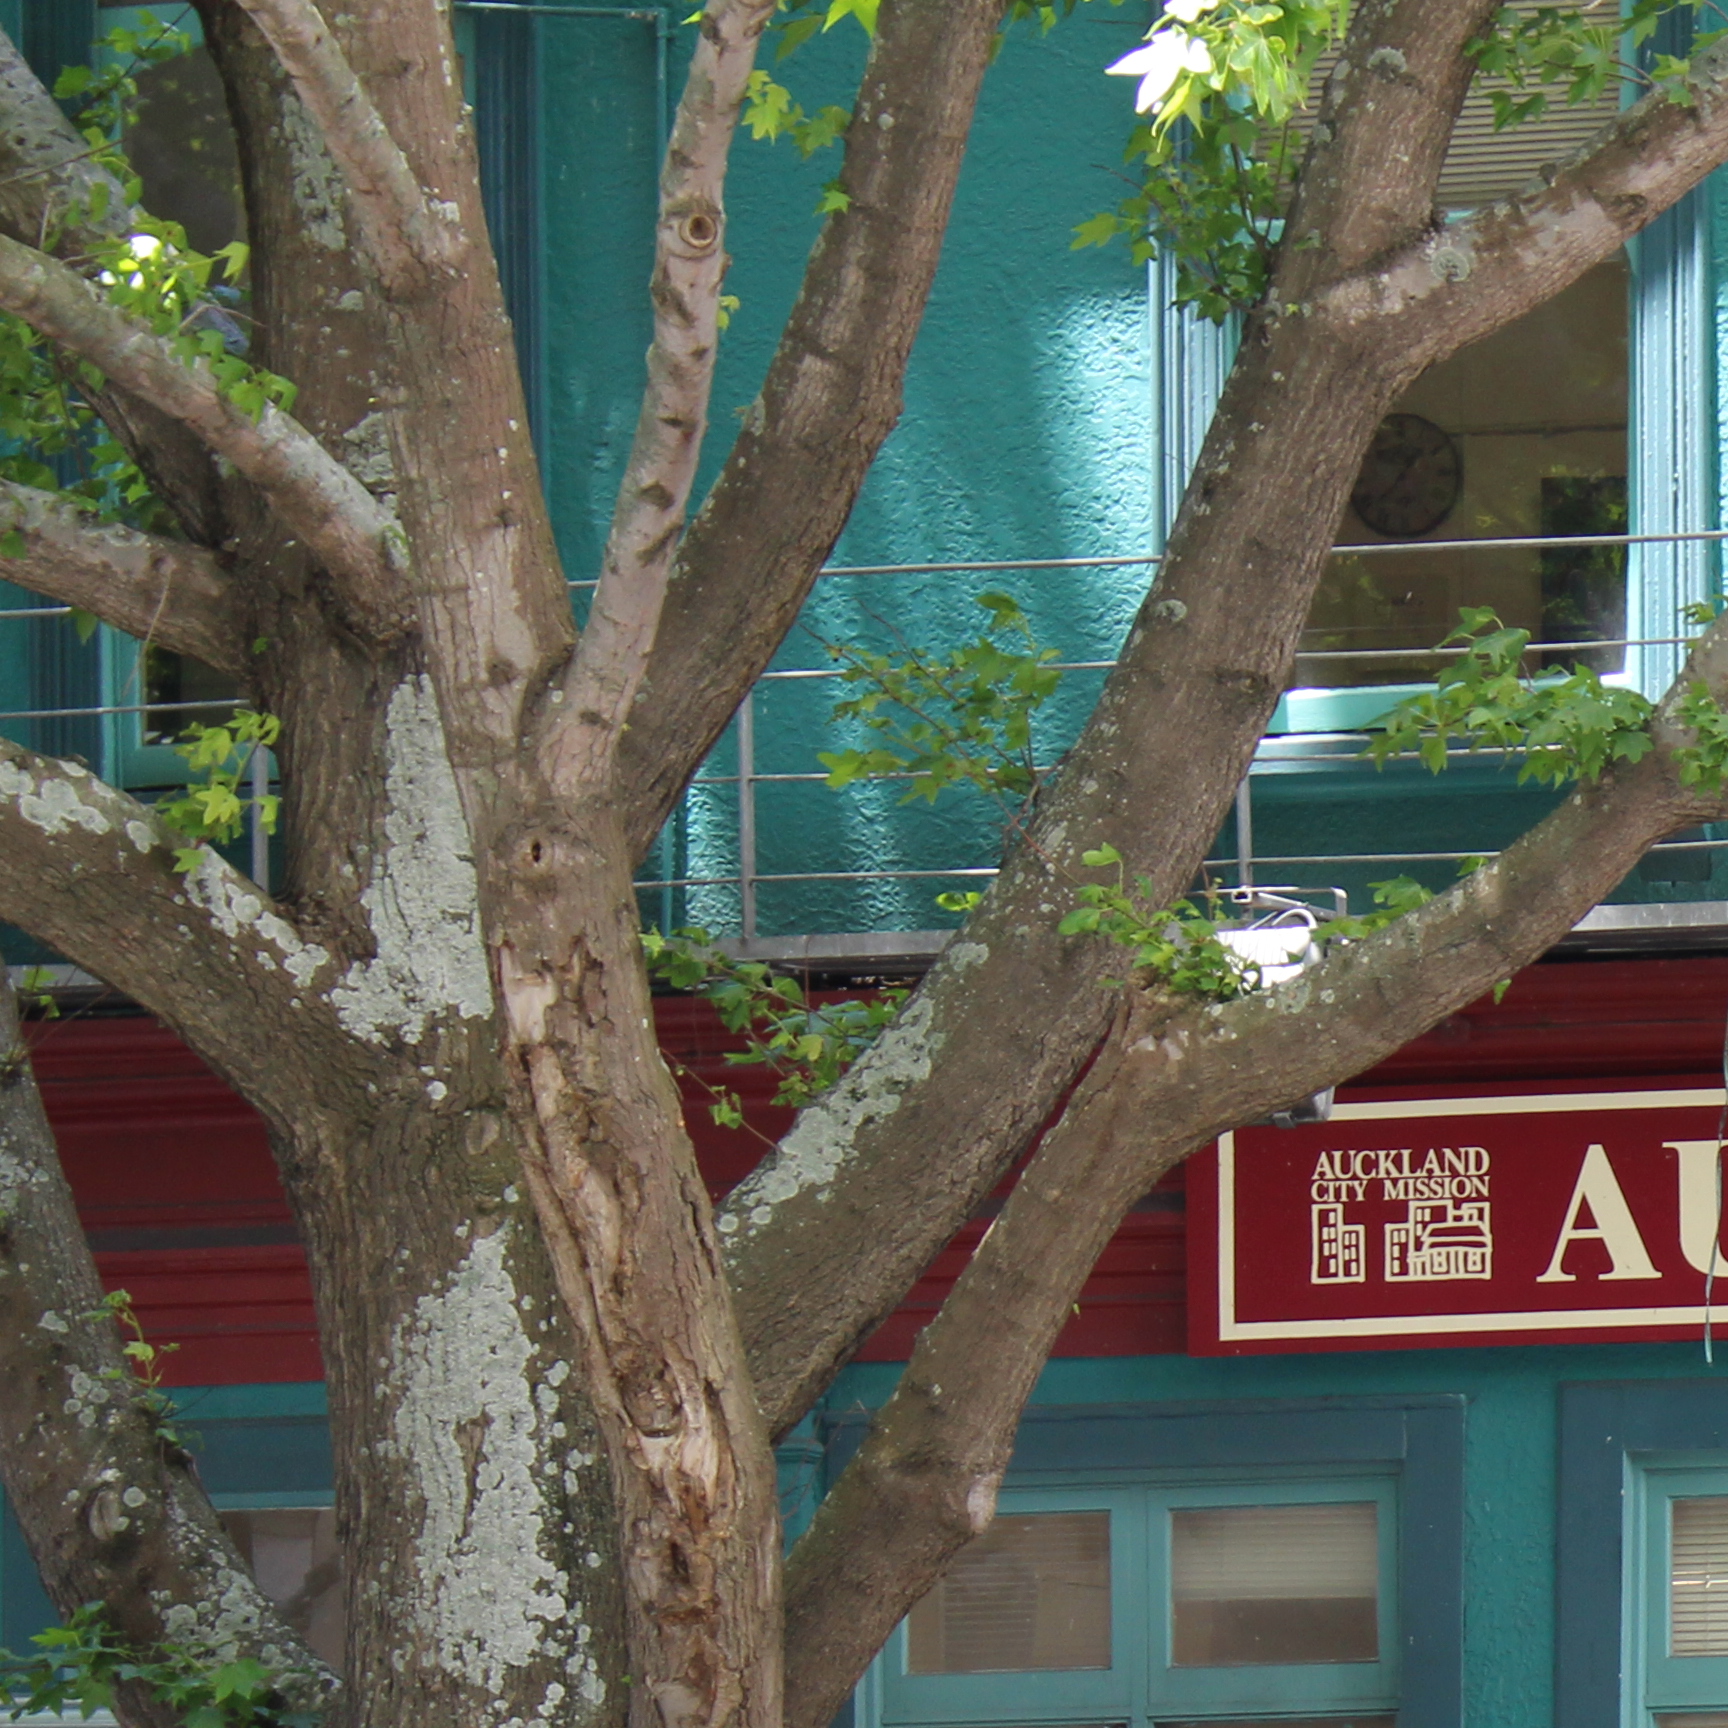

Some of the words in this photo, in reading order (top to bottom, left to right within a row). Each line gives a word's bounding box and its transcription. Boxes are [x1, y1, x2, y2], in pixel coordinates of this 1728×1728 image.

[1311, 1147, 1491, 1180] AUCKLAND
[1311, 1179, 1369, 1202] CITY
[1383, 1175, 1490, 1200] MISSION
